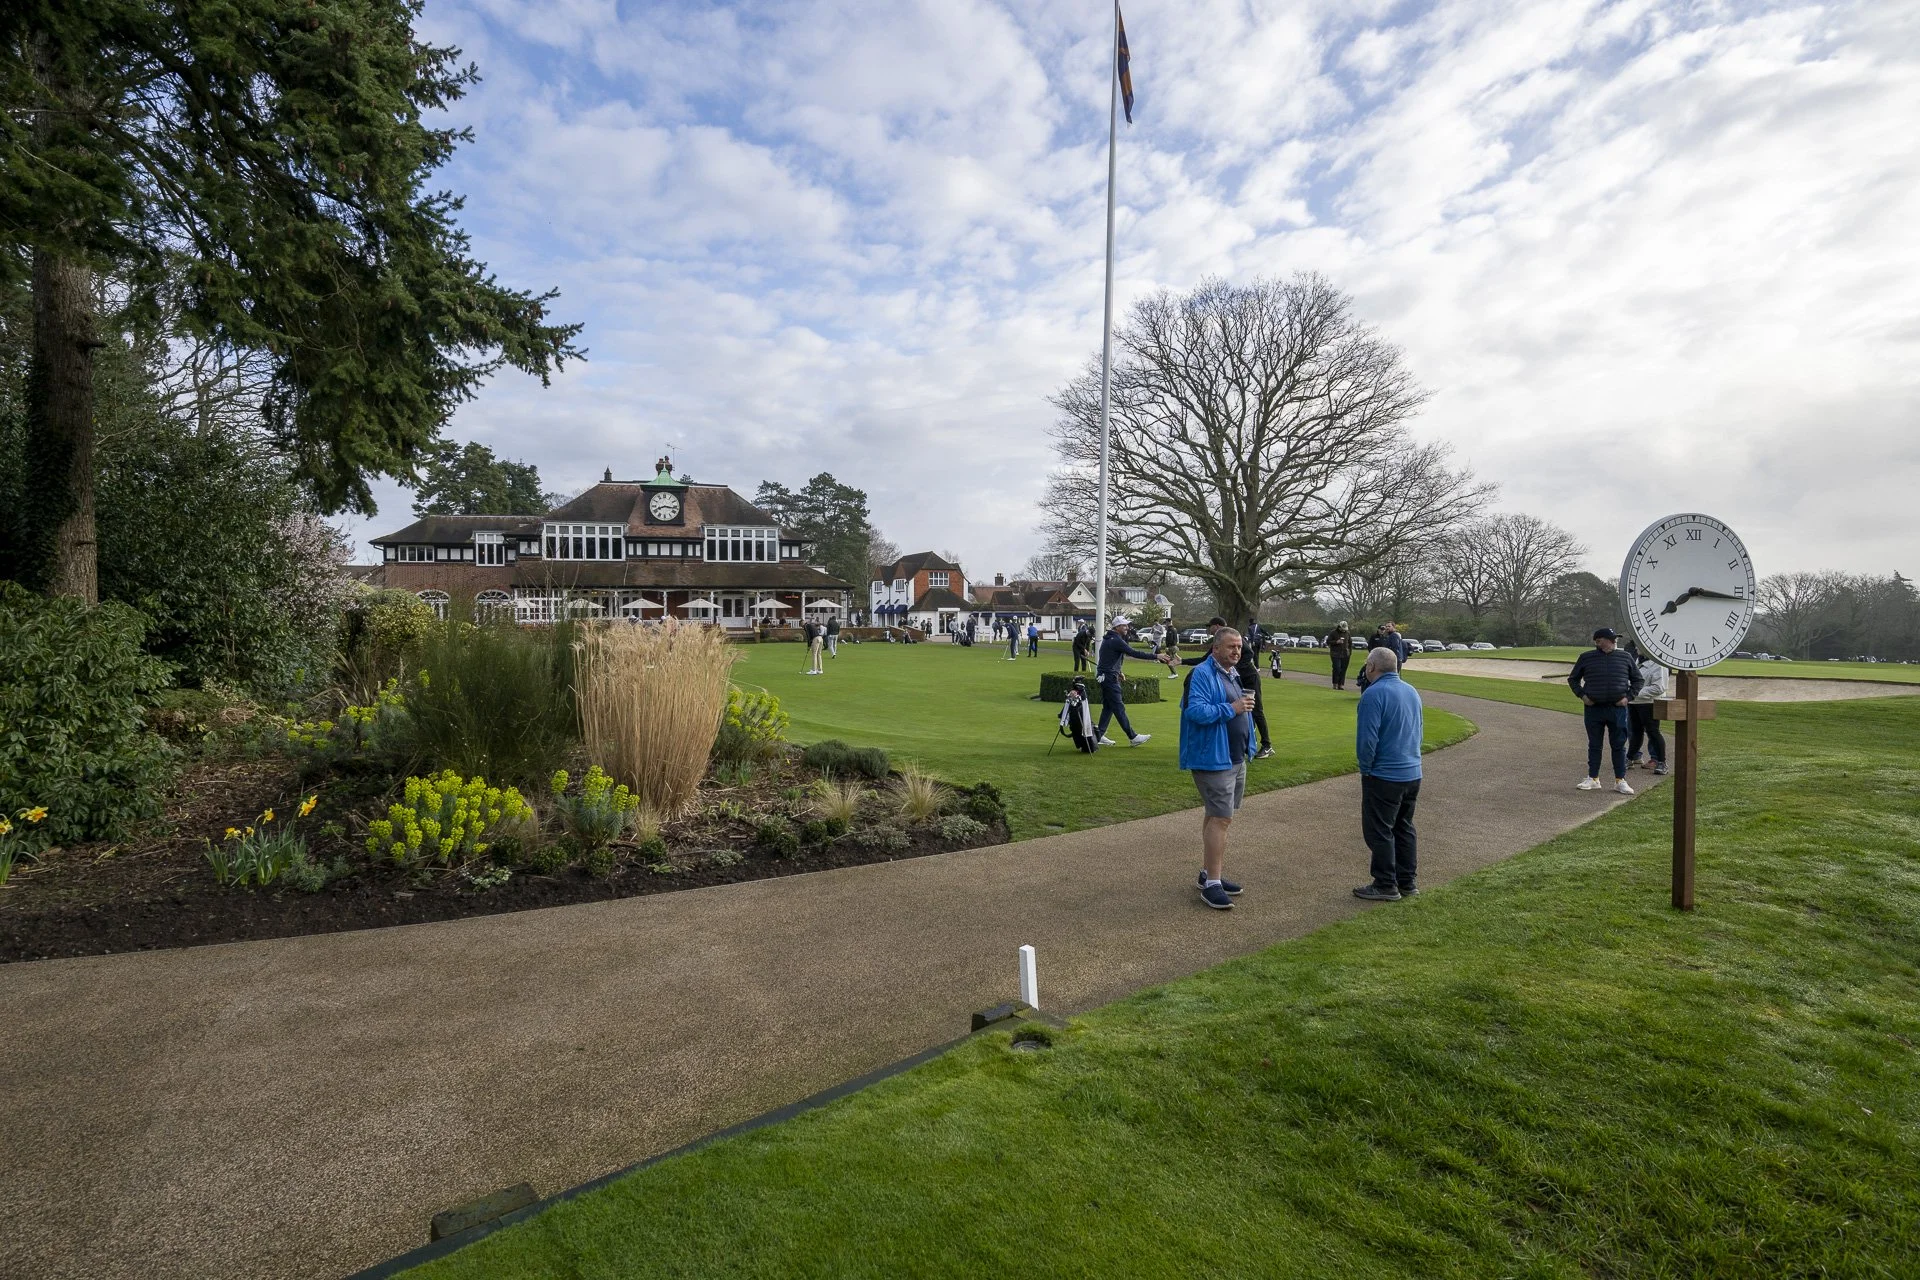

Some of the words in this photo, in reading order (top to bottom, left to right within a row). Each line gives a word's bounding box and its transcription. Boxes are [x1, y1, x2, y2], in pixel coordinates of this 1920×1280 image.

[1663, 534, 1678, 550] XI
[1686, 529, 1702, 541] XII
[1713, 538, 1721, 549] I
[1647, 556, 1658, 570] X
[1728, 558, 1739, 570] II
[1640, 584, 1650, 598] IX
[1643, 608, 1659, 633] VIII
[1725, 611, 1740, 630] IIII
[1659, 632, 1677, 651] VII
[1685, 642, 1698, 654] VI
[1712, 636, 1721, 648] V
